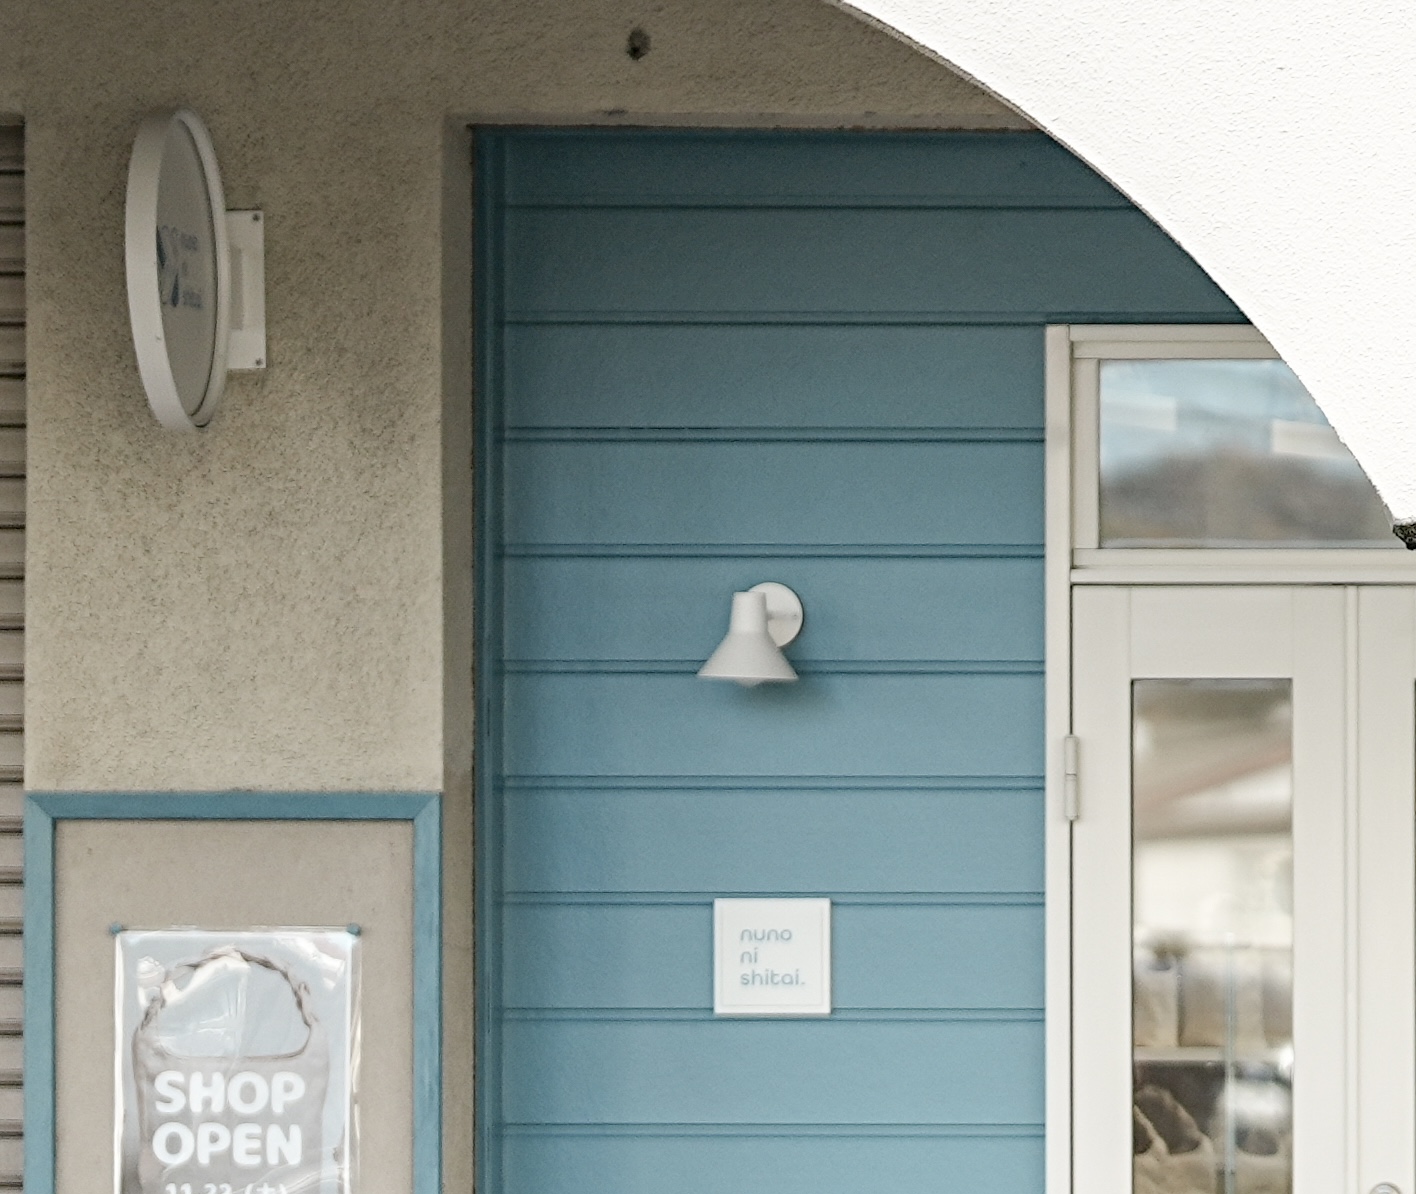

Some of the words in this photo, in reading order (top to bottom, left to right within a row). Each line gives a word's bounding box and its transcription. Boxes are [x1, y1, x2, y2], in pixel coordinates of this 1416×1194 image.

[740, 928, 792, 941] nuno
[740, 947, 759, 963] ni
[154, 1070, 306, 1114] SHOP
[152, 1122, 303, 1166] OPEN
